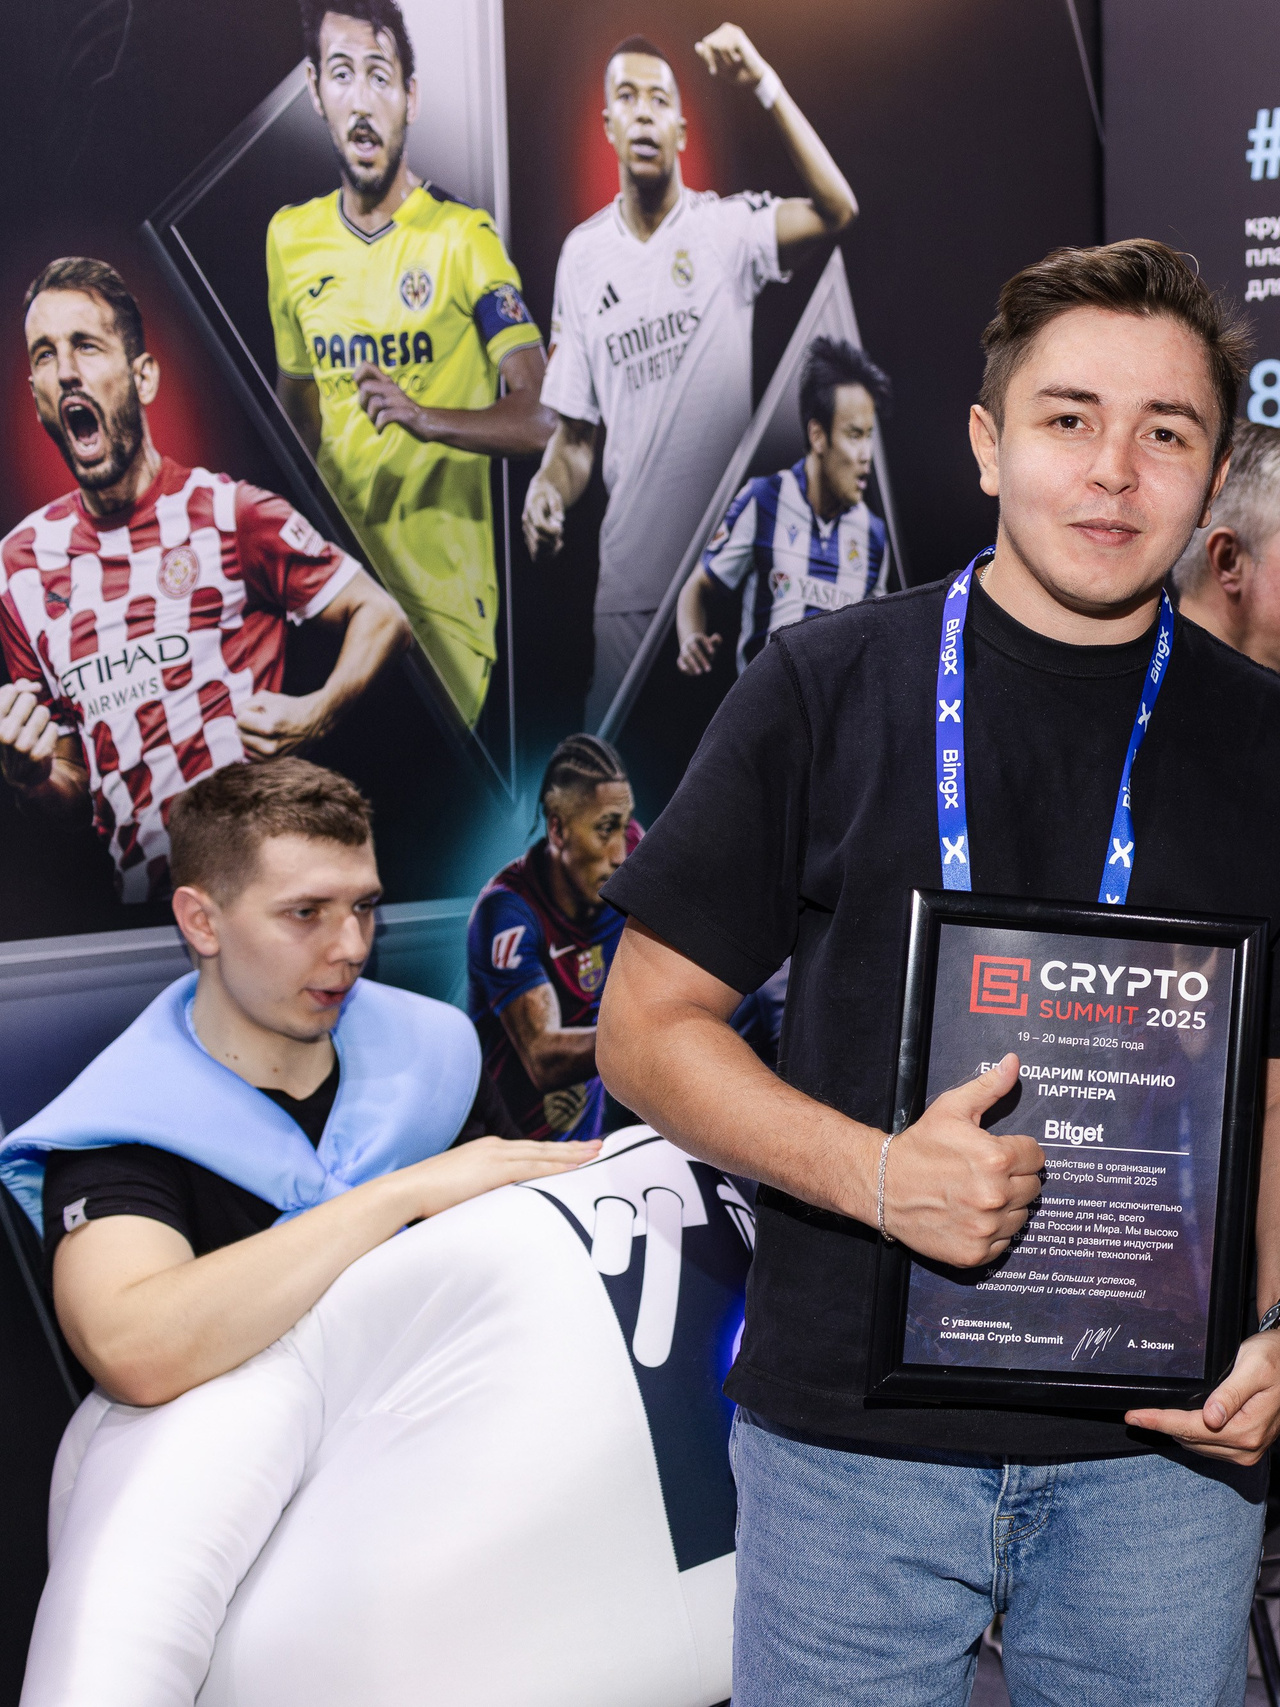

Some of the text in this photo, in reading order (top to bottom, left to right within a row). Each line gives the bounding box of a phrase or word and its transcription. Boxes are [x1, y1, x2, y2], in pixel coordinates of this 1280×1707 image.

[313, 331, 433, 369] PAMESA
[61, 634, 190, 701] ETIHAD
[87, 677, 160, 721] AIRWAYS
[1039, 960, 1209, 1002] CRYPTO
[1038, 999, 1140, 1026] SUMMIT
[1146, 1007, 1207, 1031] 2025
[1017, 1031, 1031, 1042] 19
[1041, 1033, 1056, 1044] 20
[1057, 1037, 1090, 1048] марта
[1093, 1037, 1119, 1048] 2025
[1121, 1040, 1145, 1051] года
[980, 1061, 1176, 1088] БОДАРИМ КОМПАНИЮ
[1038, 1083, 1117, 1101] ПАРТНЕРА
[1044, 1119, 1105, 1146] Bitget
[1044, 1159, 1095, 1171] одействие
[1105, 1163, 1166, 1175] организации
[1063, 1171, 1094, 1184] Crypto
[1096, 1174, 1132, 1185] Summit
[1134, 1176, 1158, 1187] 2025
[1077, 1199, 1107, 1209] имеет
[1109, 1201, 1183, 1213] исключительно
[1075, 1212, 1094, 1221] для
[1096, 1213, 1117, 1223] нас,
[1119, 1215, 1145, 1224] всего
[1047, 1221, 1083, 1232] России
[1094, 1223, 1122, 1236] Мира.
[1125, 1226, 1142, 1236] Мы
[1144, 1228, 1179, 1238] высоко
[1013, 1231, 1035, 1243] Ваш
[1037, 1234, 1067, 1246] вклад
[1077, 1237, 1122, 1249] развитие
[1123, 1240, 1174, 1252] индустрии
[1040, 1247, 1047, 1255] и
[1049, 1245, 1095, 1259] блокчейн
[1097, 1249, 1154, 1262] технологий.
[985, 1268, 1138, 1287] Желаем Вам больших успехов,
[1046, 1285, 1053, 1294] и
[1055, 1286, 1086, 1296] новых
[1088, 1288, 1147, 1300] свершений!
[941, 1316, 1013, 1331] С уважением,
[940, 1330, 1175, 1351] команда Crypto Summit А. Зюзин
